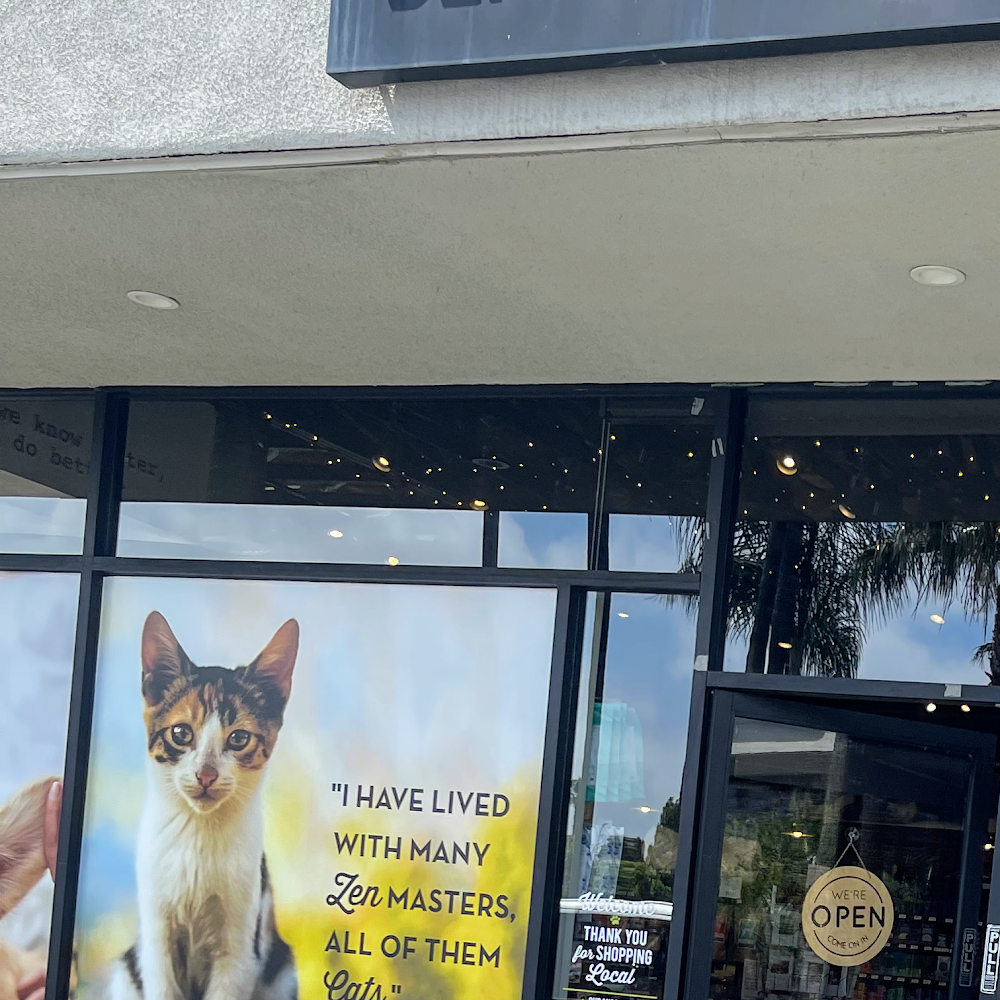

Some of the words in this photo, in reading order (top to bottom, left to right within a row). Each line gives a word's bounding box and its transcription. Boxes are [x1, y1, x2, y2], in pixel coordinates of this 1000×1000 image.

[356, 784, 424, 812] HAVE
[432, 789, 510, 818] LIVED
[334, 832, 402, 860] WITH
[410, 838, 491, 866] MANY
[326, 872, 384, 915] Zen
[387, 885, 516, 923] MASTERS,
[578, 892, 656, 915] Welcome
[831, 889, 867, 900] WE'RE
[811, 904, 885, 928] OPEN
[584, 925, 622, 944] THANK
[626, 929, 648, 946] YOU
[827, 935, 847, 949] COME
[848, 939, 860, 949] ON
[860, 935, 869, 945] IN
[324, 930, 372, 956] ALL
[380, 935, 418, 960] OF
[425, 938, 501, 968] THEM
[572, 945, 595, 963] for
[596, 945, 653, 966] SHOPPING
[962, 933, 974, 973] PULL
[986, 931, 1000, 976] PULL
[585, 963, 636, 986] Local
